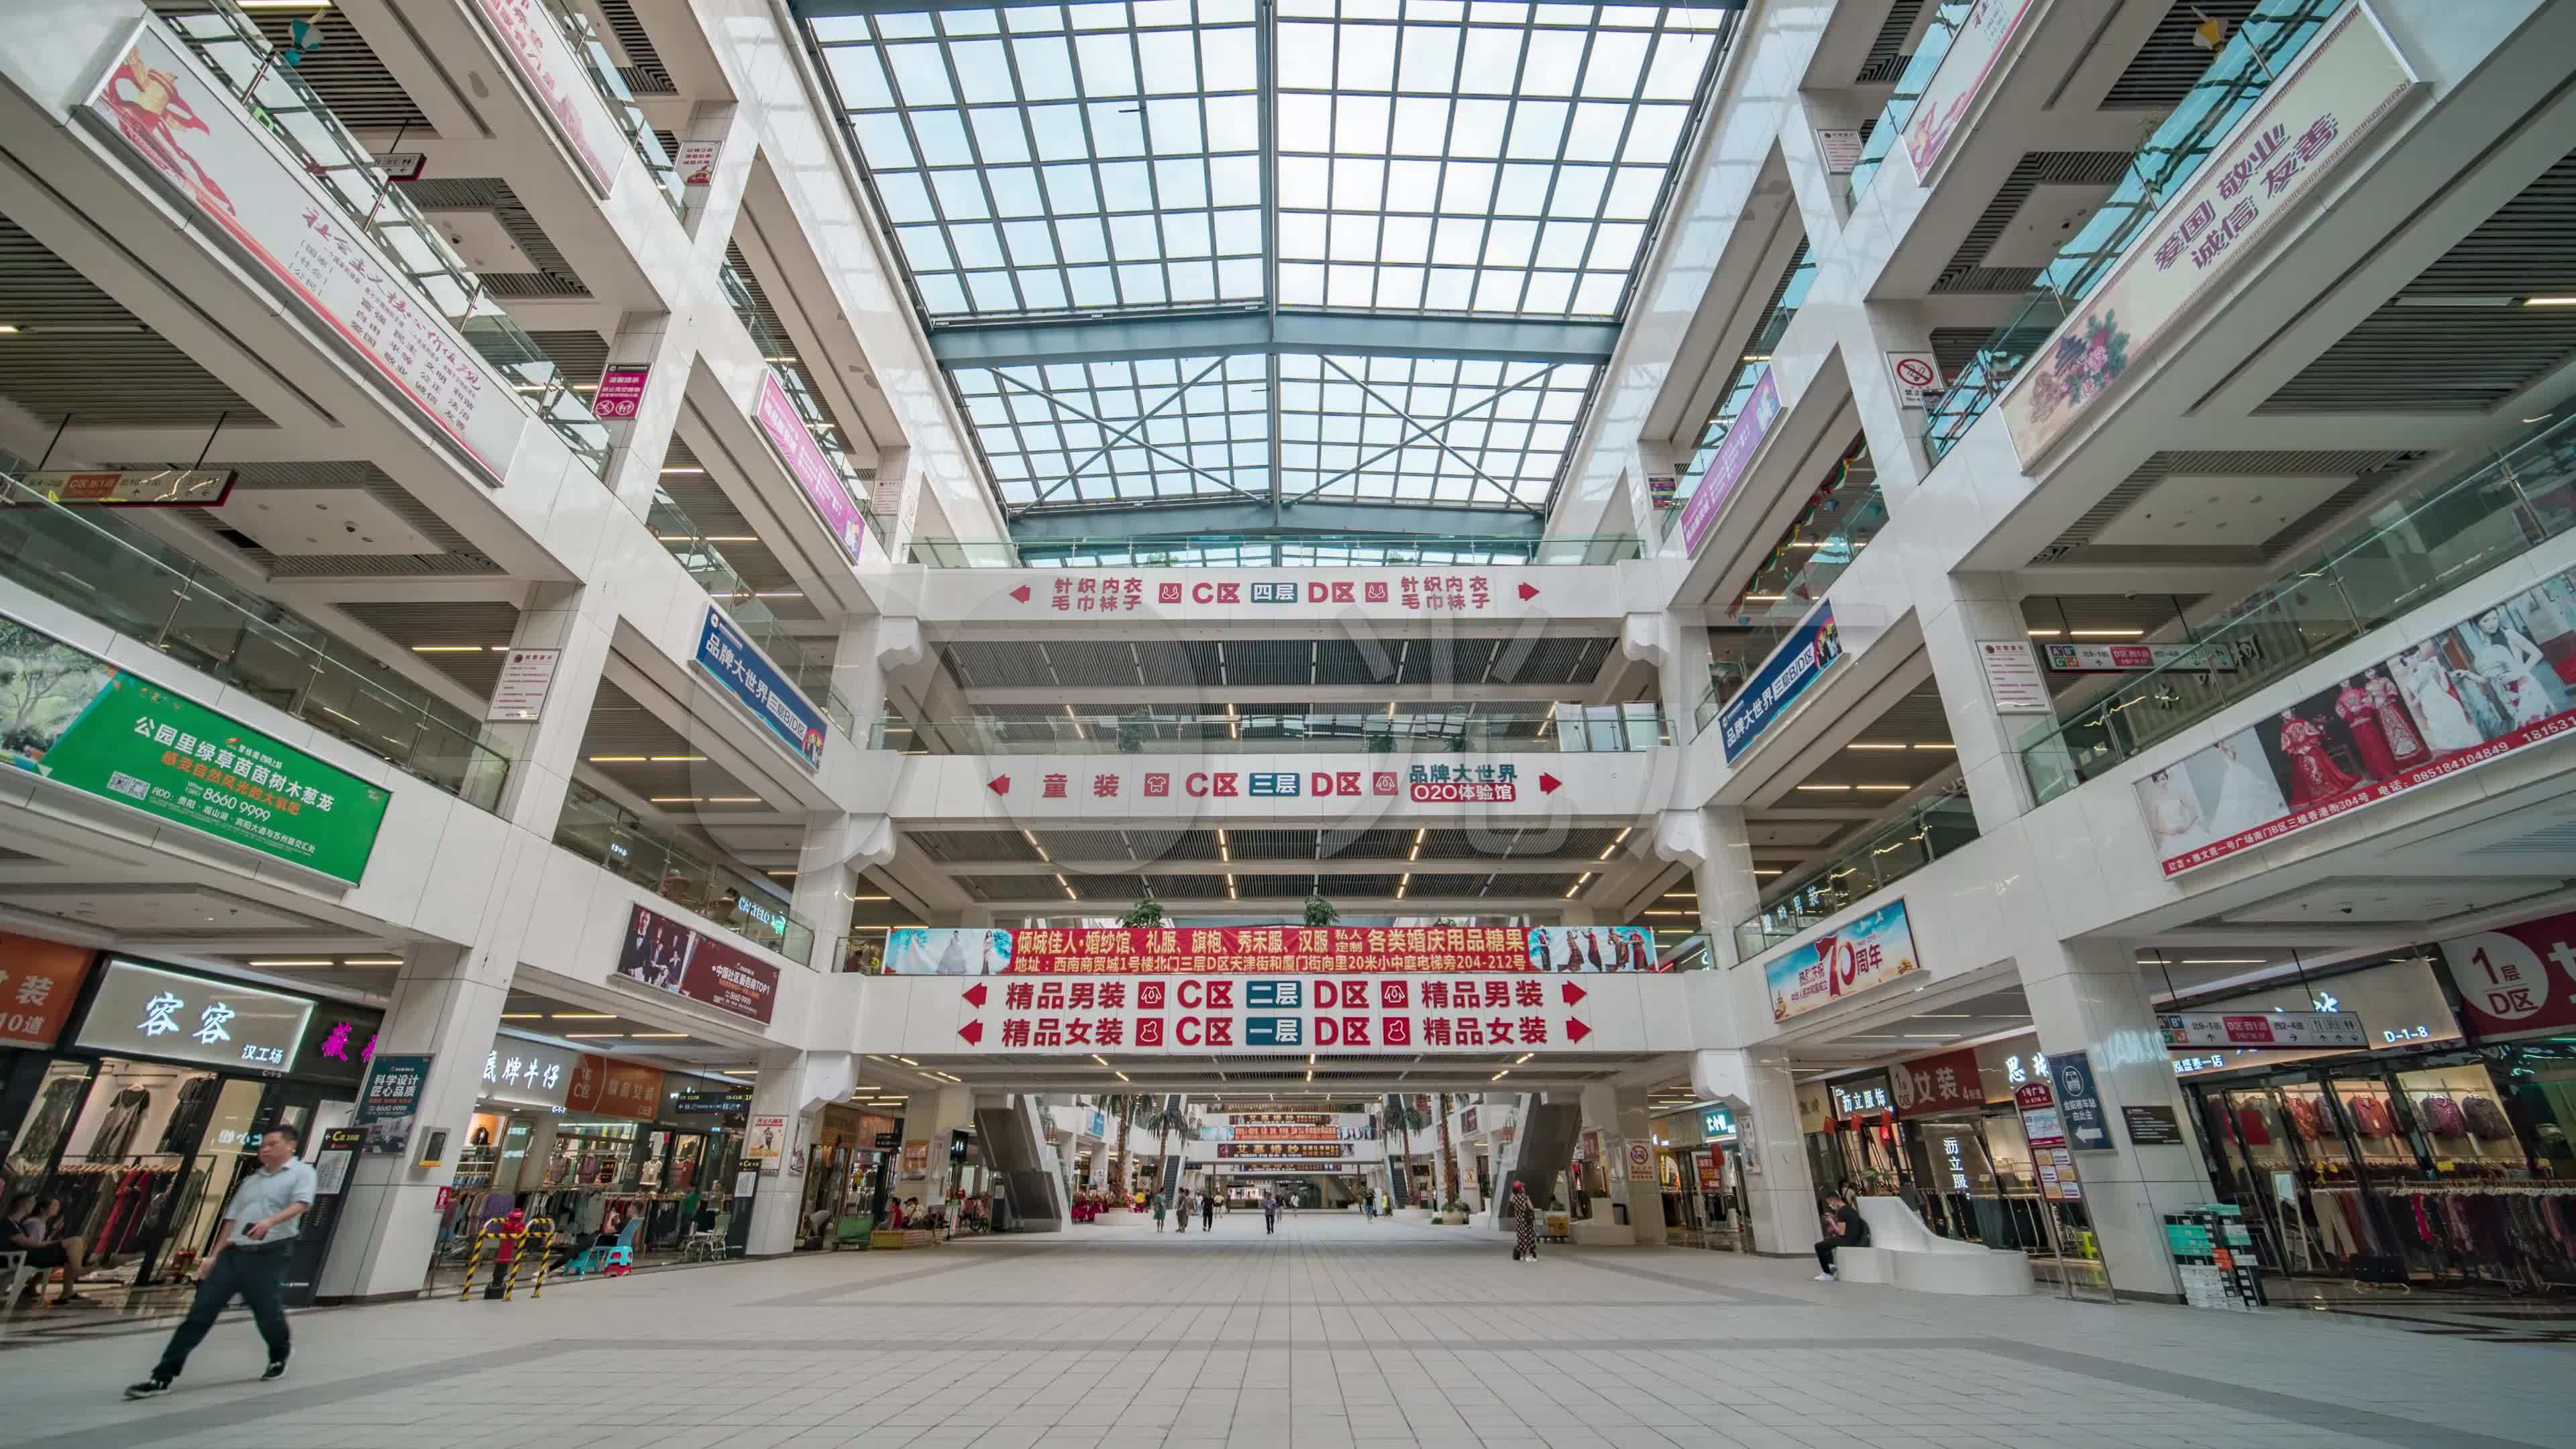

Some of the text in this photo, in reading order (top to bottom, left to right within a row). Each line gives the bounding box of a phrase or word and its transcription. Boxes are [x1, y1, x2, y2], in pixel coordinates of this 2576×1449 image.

[2154, 123, 2290, 273] 爱国 敬业
[2191, 113, 2339, 270] 诚信 友善
[1055, 578, 1142, 594] 针织内衣
[1192, 582, 1355, 604] C区 四层 D区
[1401, 576, 1489, 592] 针织内衣
[1052, 595, 1142, 612] 毛巾袜子
[1401, 594, 1490, 610] 毛巾袜子
[706, 633, 768, 703] 品牌大世界
[1726, 687, 1773, 748] 品牌大世界
[133, 716, 335, 812] 公园里绿草茵茵树木葱茏
[1409, 763, 1518, 784] 品牌大世界
[1042, 772, 1362, 798] 童装 C区 三层 D区
[203, 787, 237, 810] 8660
[239, 800, 271, 822] 9999
[1335, 929, 1362, 941] 私人
[1335, 942, 1362, 954] 定制
[1368, 928, 1525, 953] 各类婚庆用品糖果
[1856, 944, 1882, 975] 周年
[2471, 946, 2522, 984] 1层
[1006, 979, 1544, 1010] 精品男装 C区 二层 D区 精品男装
[2487, 987, 2539, 1015] D区
[138, 992, 237, 1044] 容容
[1002, 1016, 1548, 1047] 精品女装 C区 一层 D区 精品女装
[2383, 1026, 2430, 1042] D-1-8
[241, 1044, 284, 1064] 汉工场
[370, 1086, 416, 1097] 匠心品质
[374, 1074, 419, 1085] 科学设计
[1915, 1068, 1959, 1103] 女装
